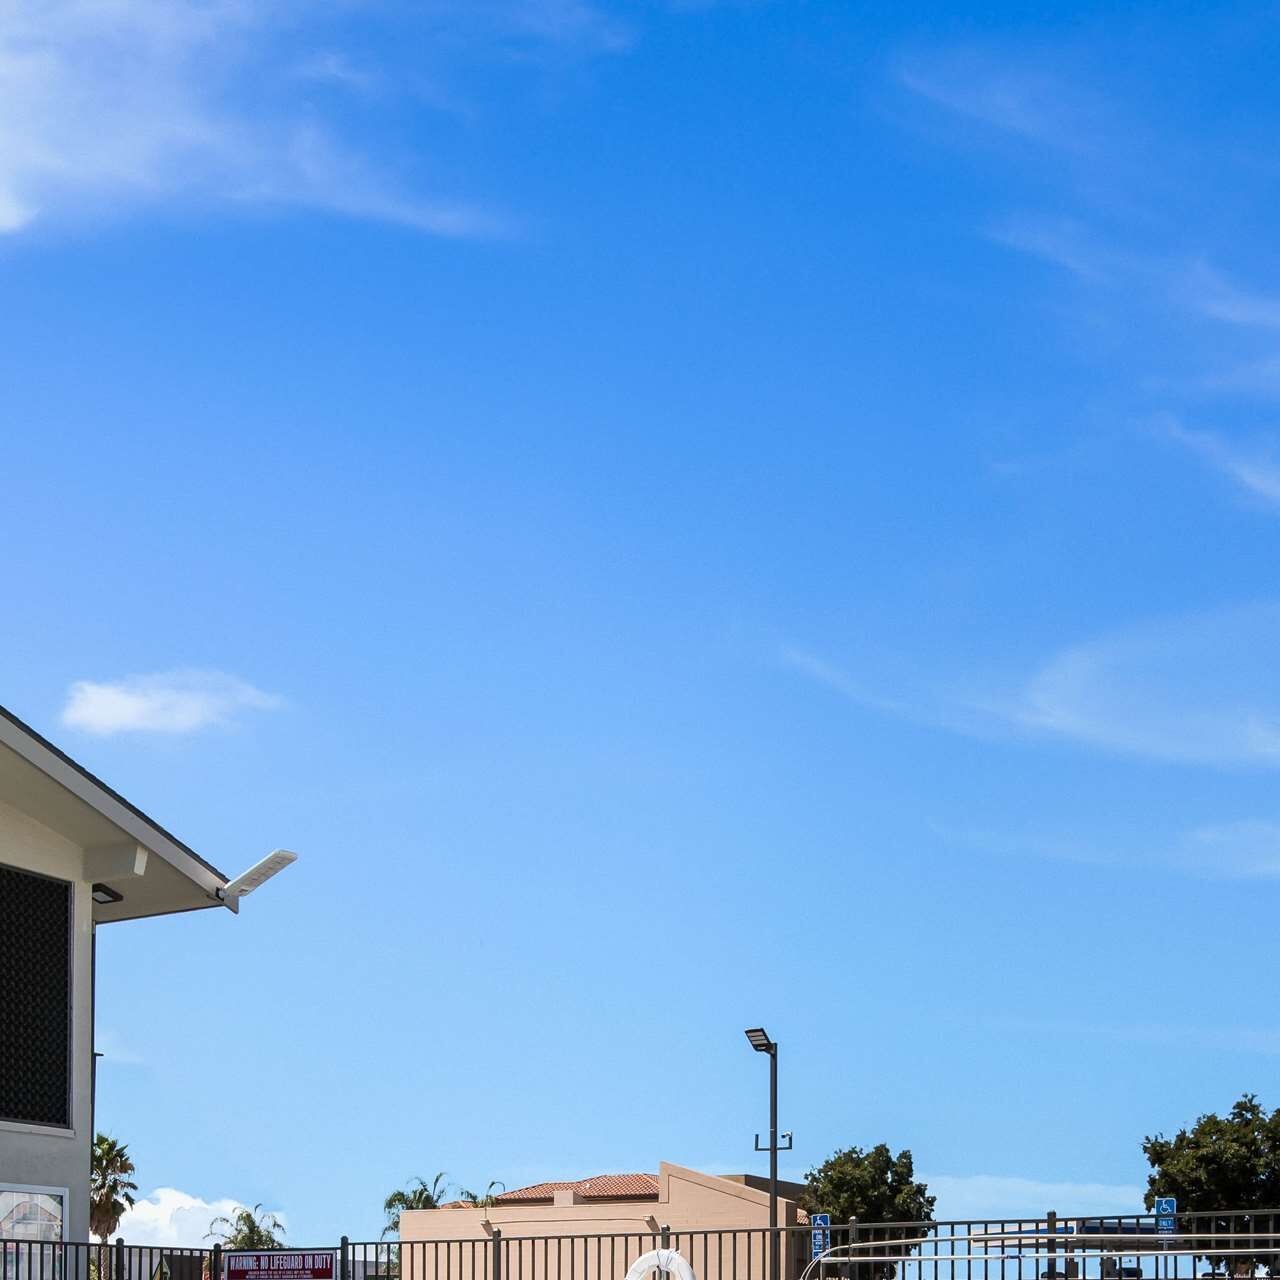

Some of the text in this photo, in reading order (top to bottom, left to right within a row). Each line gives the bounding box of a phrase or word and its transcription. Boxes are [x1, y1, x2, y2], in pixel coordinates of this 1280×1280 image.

[230, 1254, 332, 1270] WARNING: NO LIFEGUARD ON DUTY
